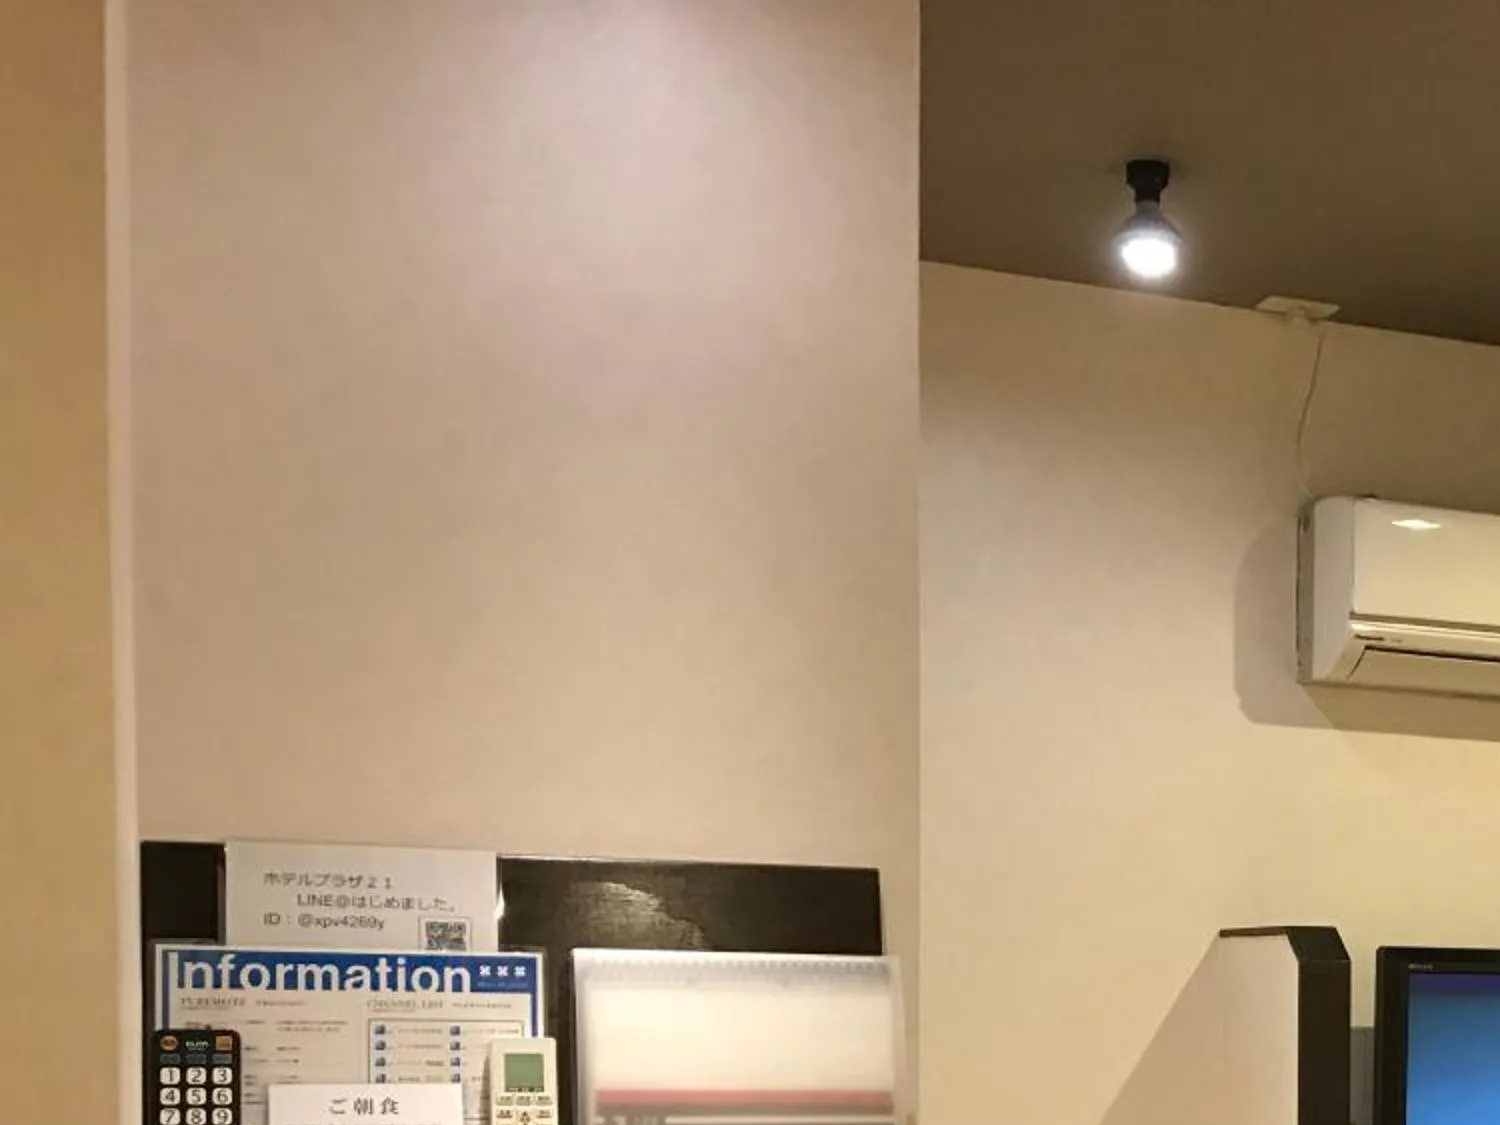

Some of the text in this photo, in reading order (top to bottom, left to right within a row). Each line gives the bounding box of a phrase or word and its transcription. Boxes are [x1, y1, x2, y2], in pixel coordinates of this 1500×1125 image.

[168, 951, 471, 993] Information
[329, 1097, 400, 1115] ご朝食
